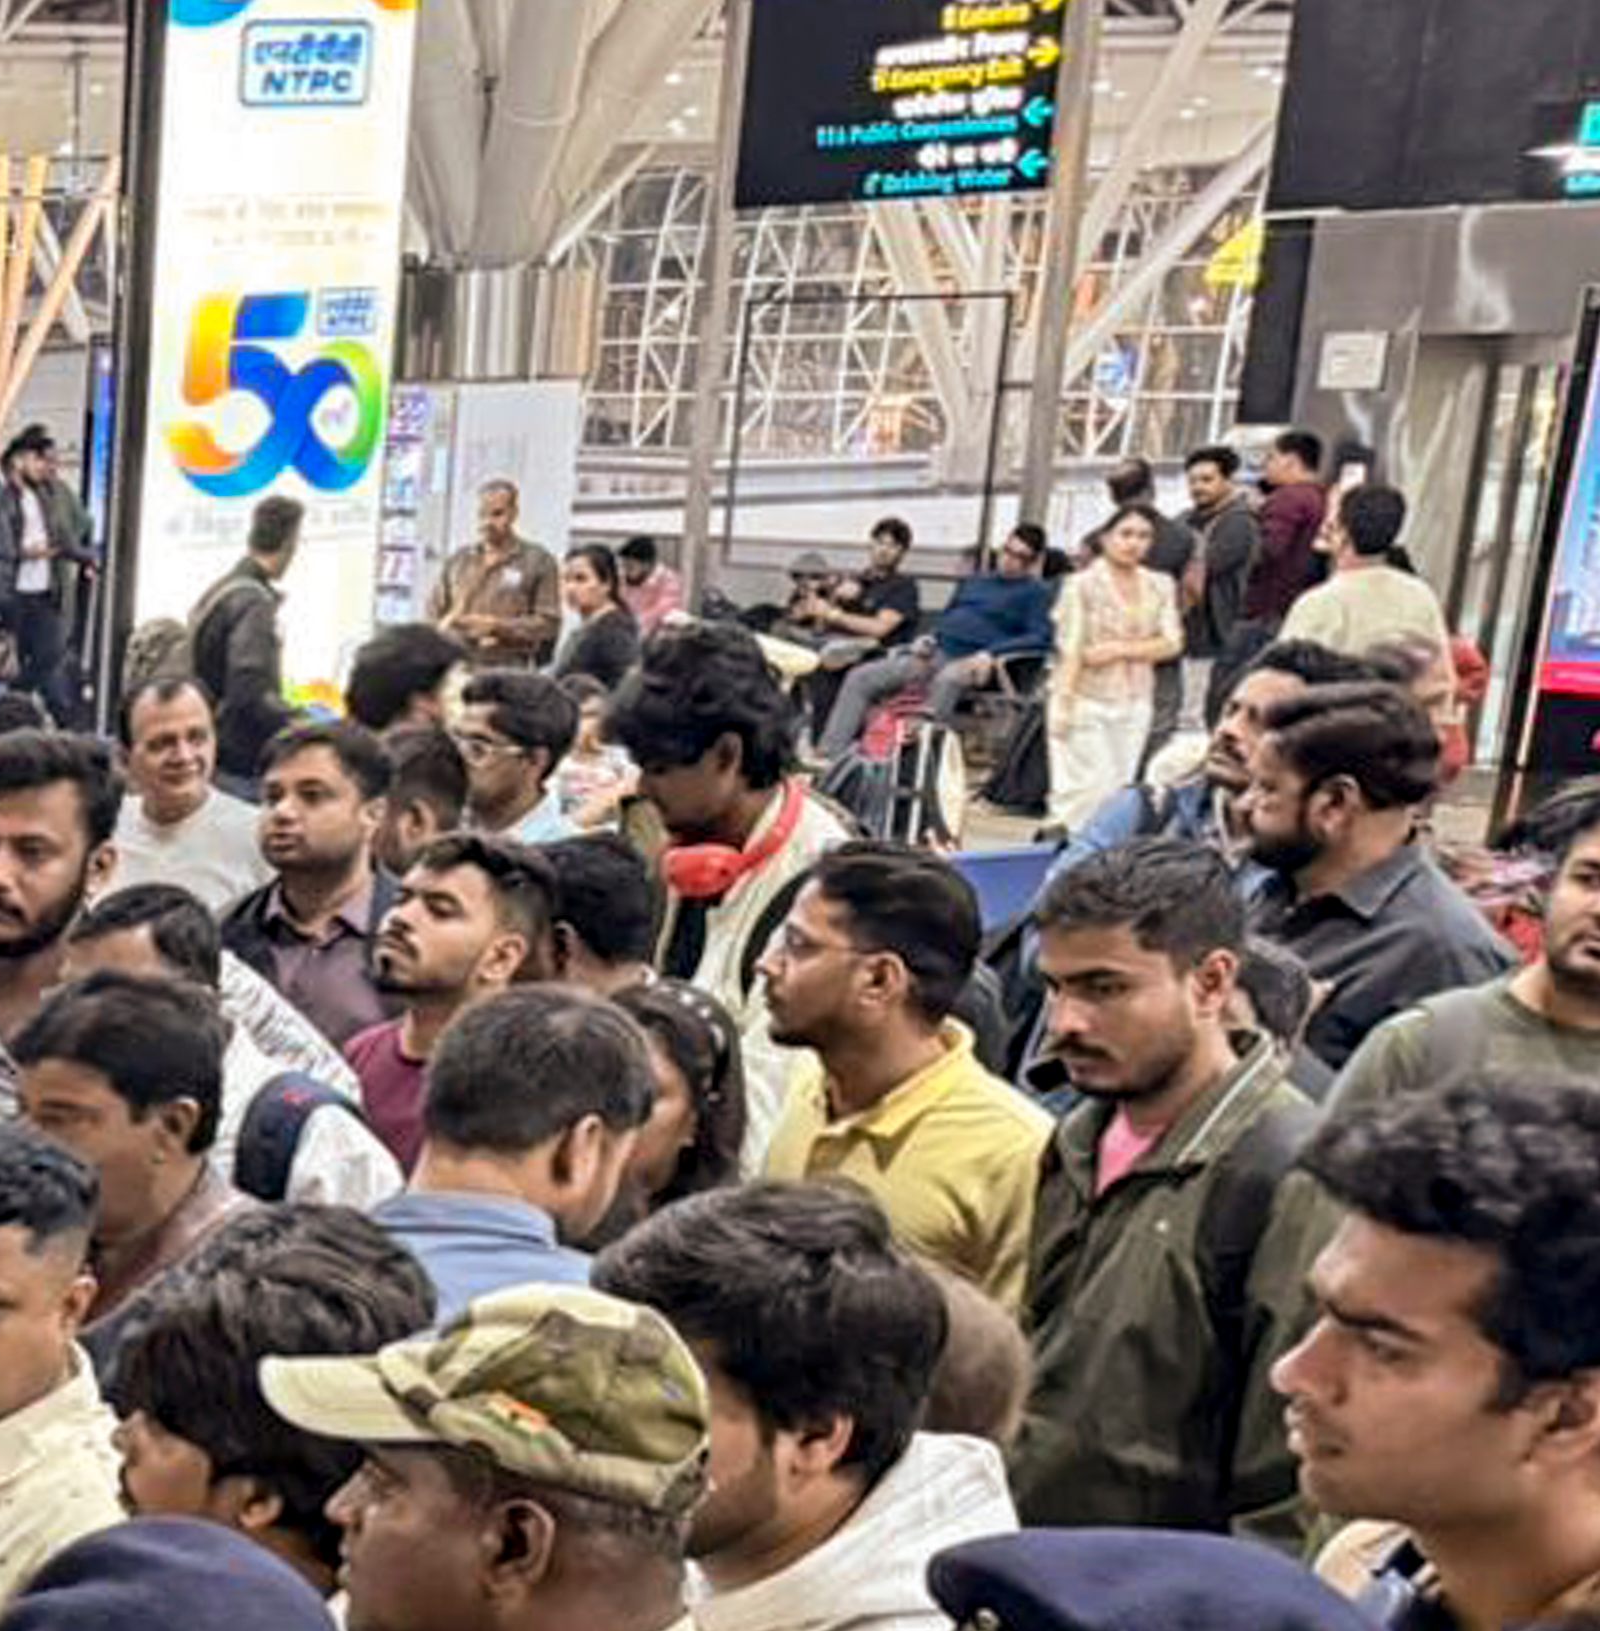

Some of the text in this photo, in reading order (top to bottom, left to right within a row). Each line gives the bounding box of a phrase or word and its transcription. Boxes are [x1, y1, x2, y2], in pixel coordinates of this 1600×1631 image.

[262, 70, 352, 93] NTPC
[851, 120, 897, 142] Public
[882, 168, 1013, 194] Drinking Water
[163, 288, 381, 497] 50
